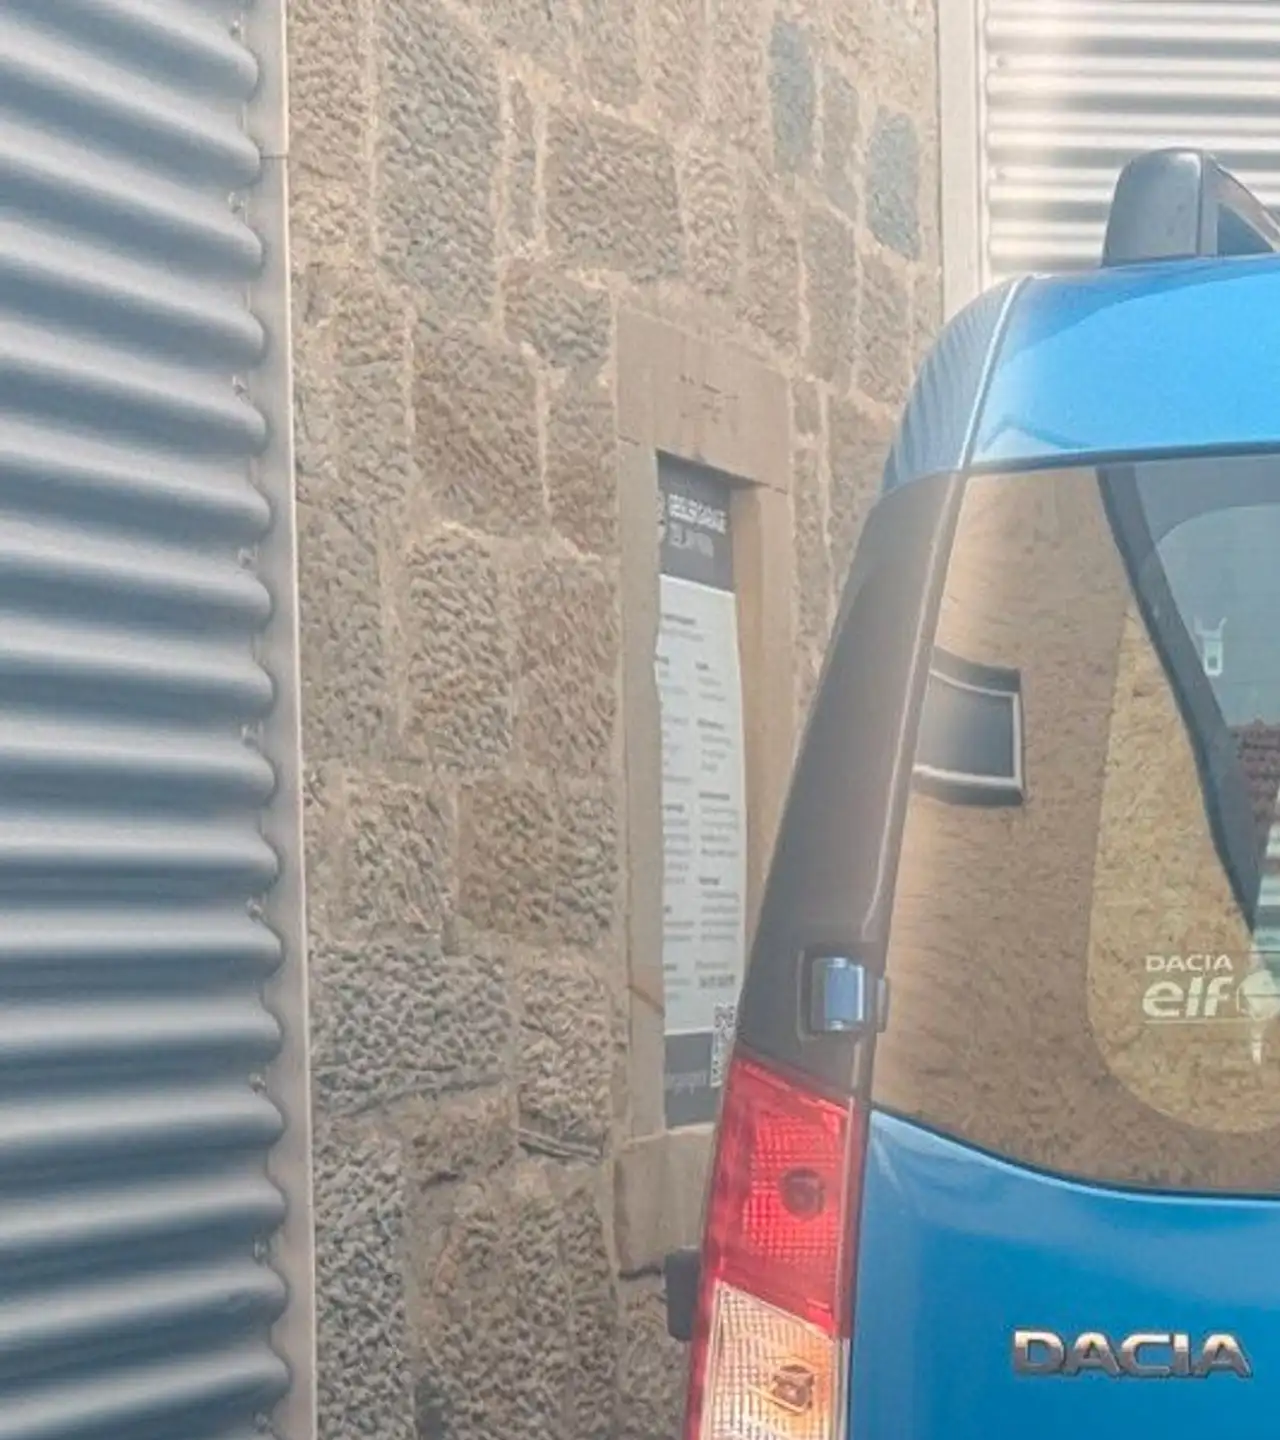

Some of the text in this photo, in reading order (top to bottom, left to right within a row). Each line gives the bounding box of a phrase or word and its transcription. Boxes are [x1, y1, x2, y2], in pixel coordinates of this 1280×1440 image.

[1145, 954, 1233, 972] DACIA
[1142, 976, 1234, 1017] elf
[1012, 1330, 1253, 1378] DACIA
